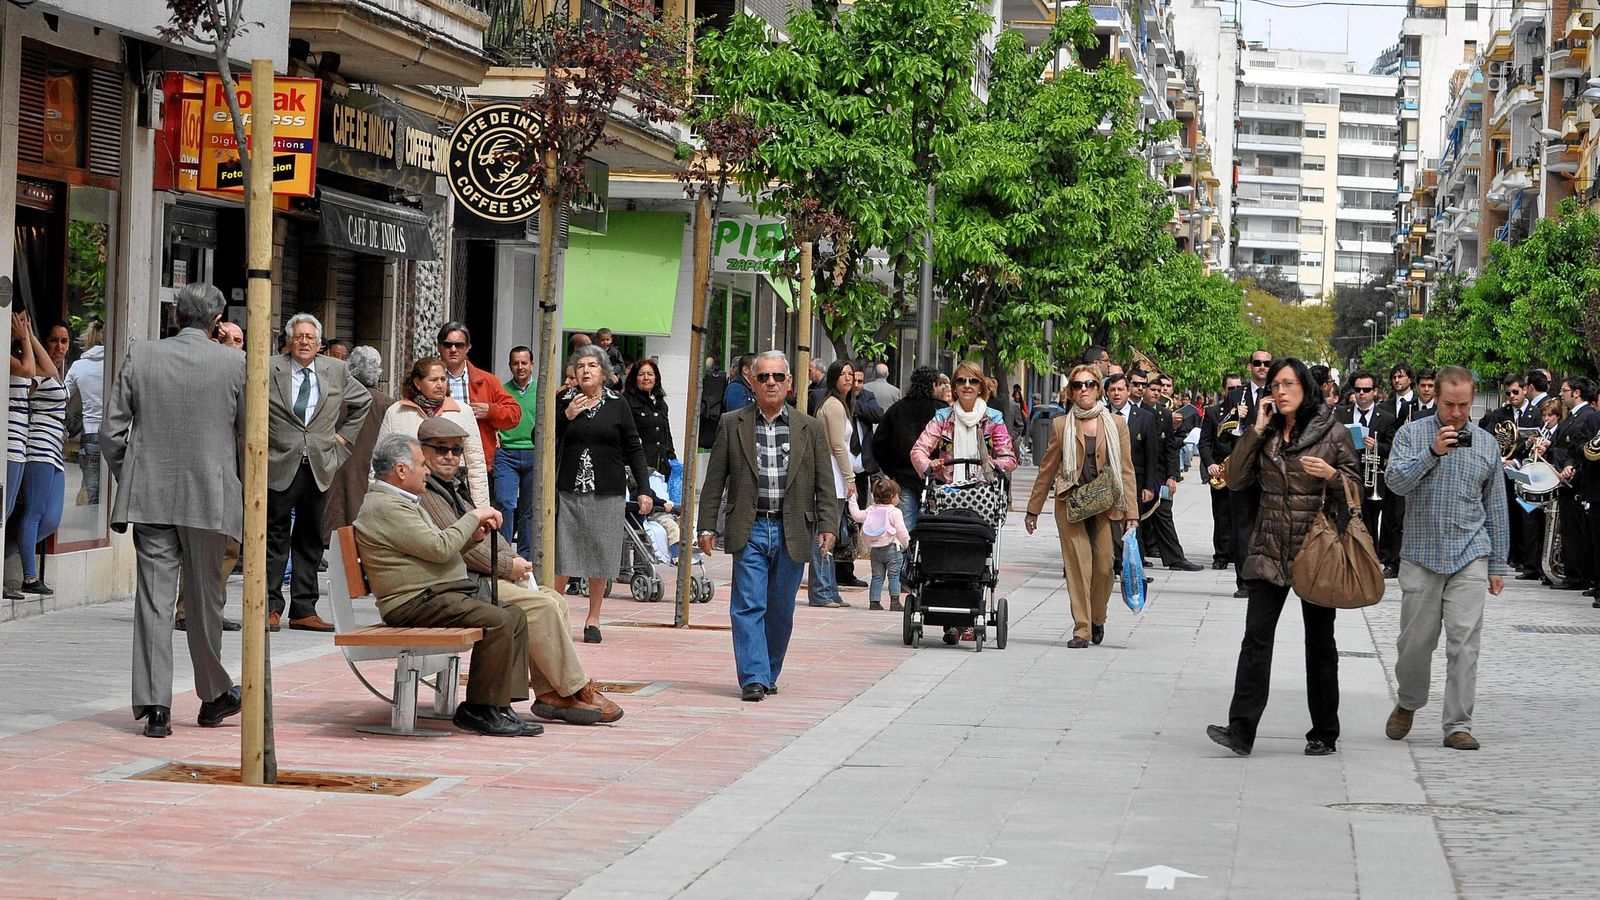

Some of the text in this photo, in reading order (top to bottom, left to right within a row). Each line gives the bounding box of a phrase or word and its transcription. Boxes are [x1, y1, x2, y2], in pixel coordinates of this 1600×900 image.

[214, 83, 306, 112] Koak
[212, 111, 306, 127] epess
[333, 103, 394, 159] CAFE DE INDIAS
[456, 117, 488, 152] CAFE
[489, 111, 510, 125] DE
[457, 176, 508, 214] COFFEE
[348, 212, 406, 253] CAFÉ DE INDIAS
